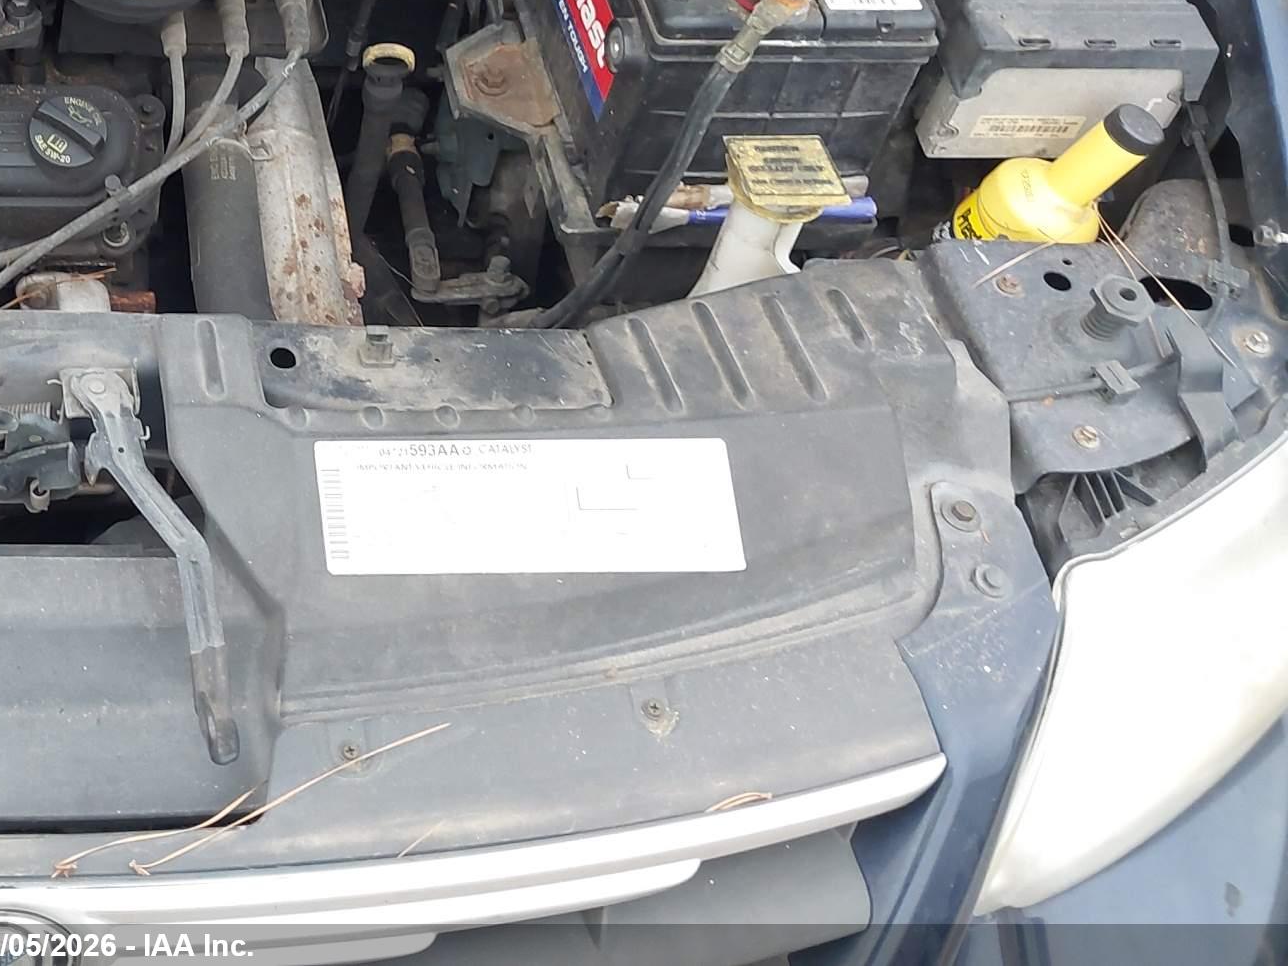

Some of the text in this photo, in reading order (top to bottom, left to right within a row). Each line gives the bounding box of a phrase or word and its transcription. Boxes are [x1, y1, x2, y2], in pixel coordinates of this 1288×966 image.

[568, 21, 588, 74] TOUGH
[63, 96, 94, 112] ENGINE
[34, 134, 72, 164] SAE 5W-20
